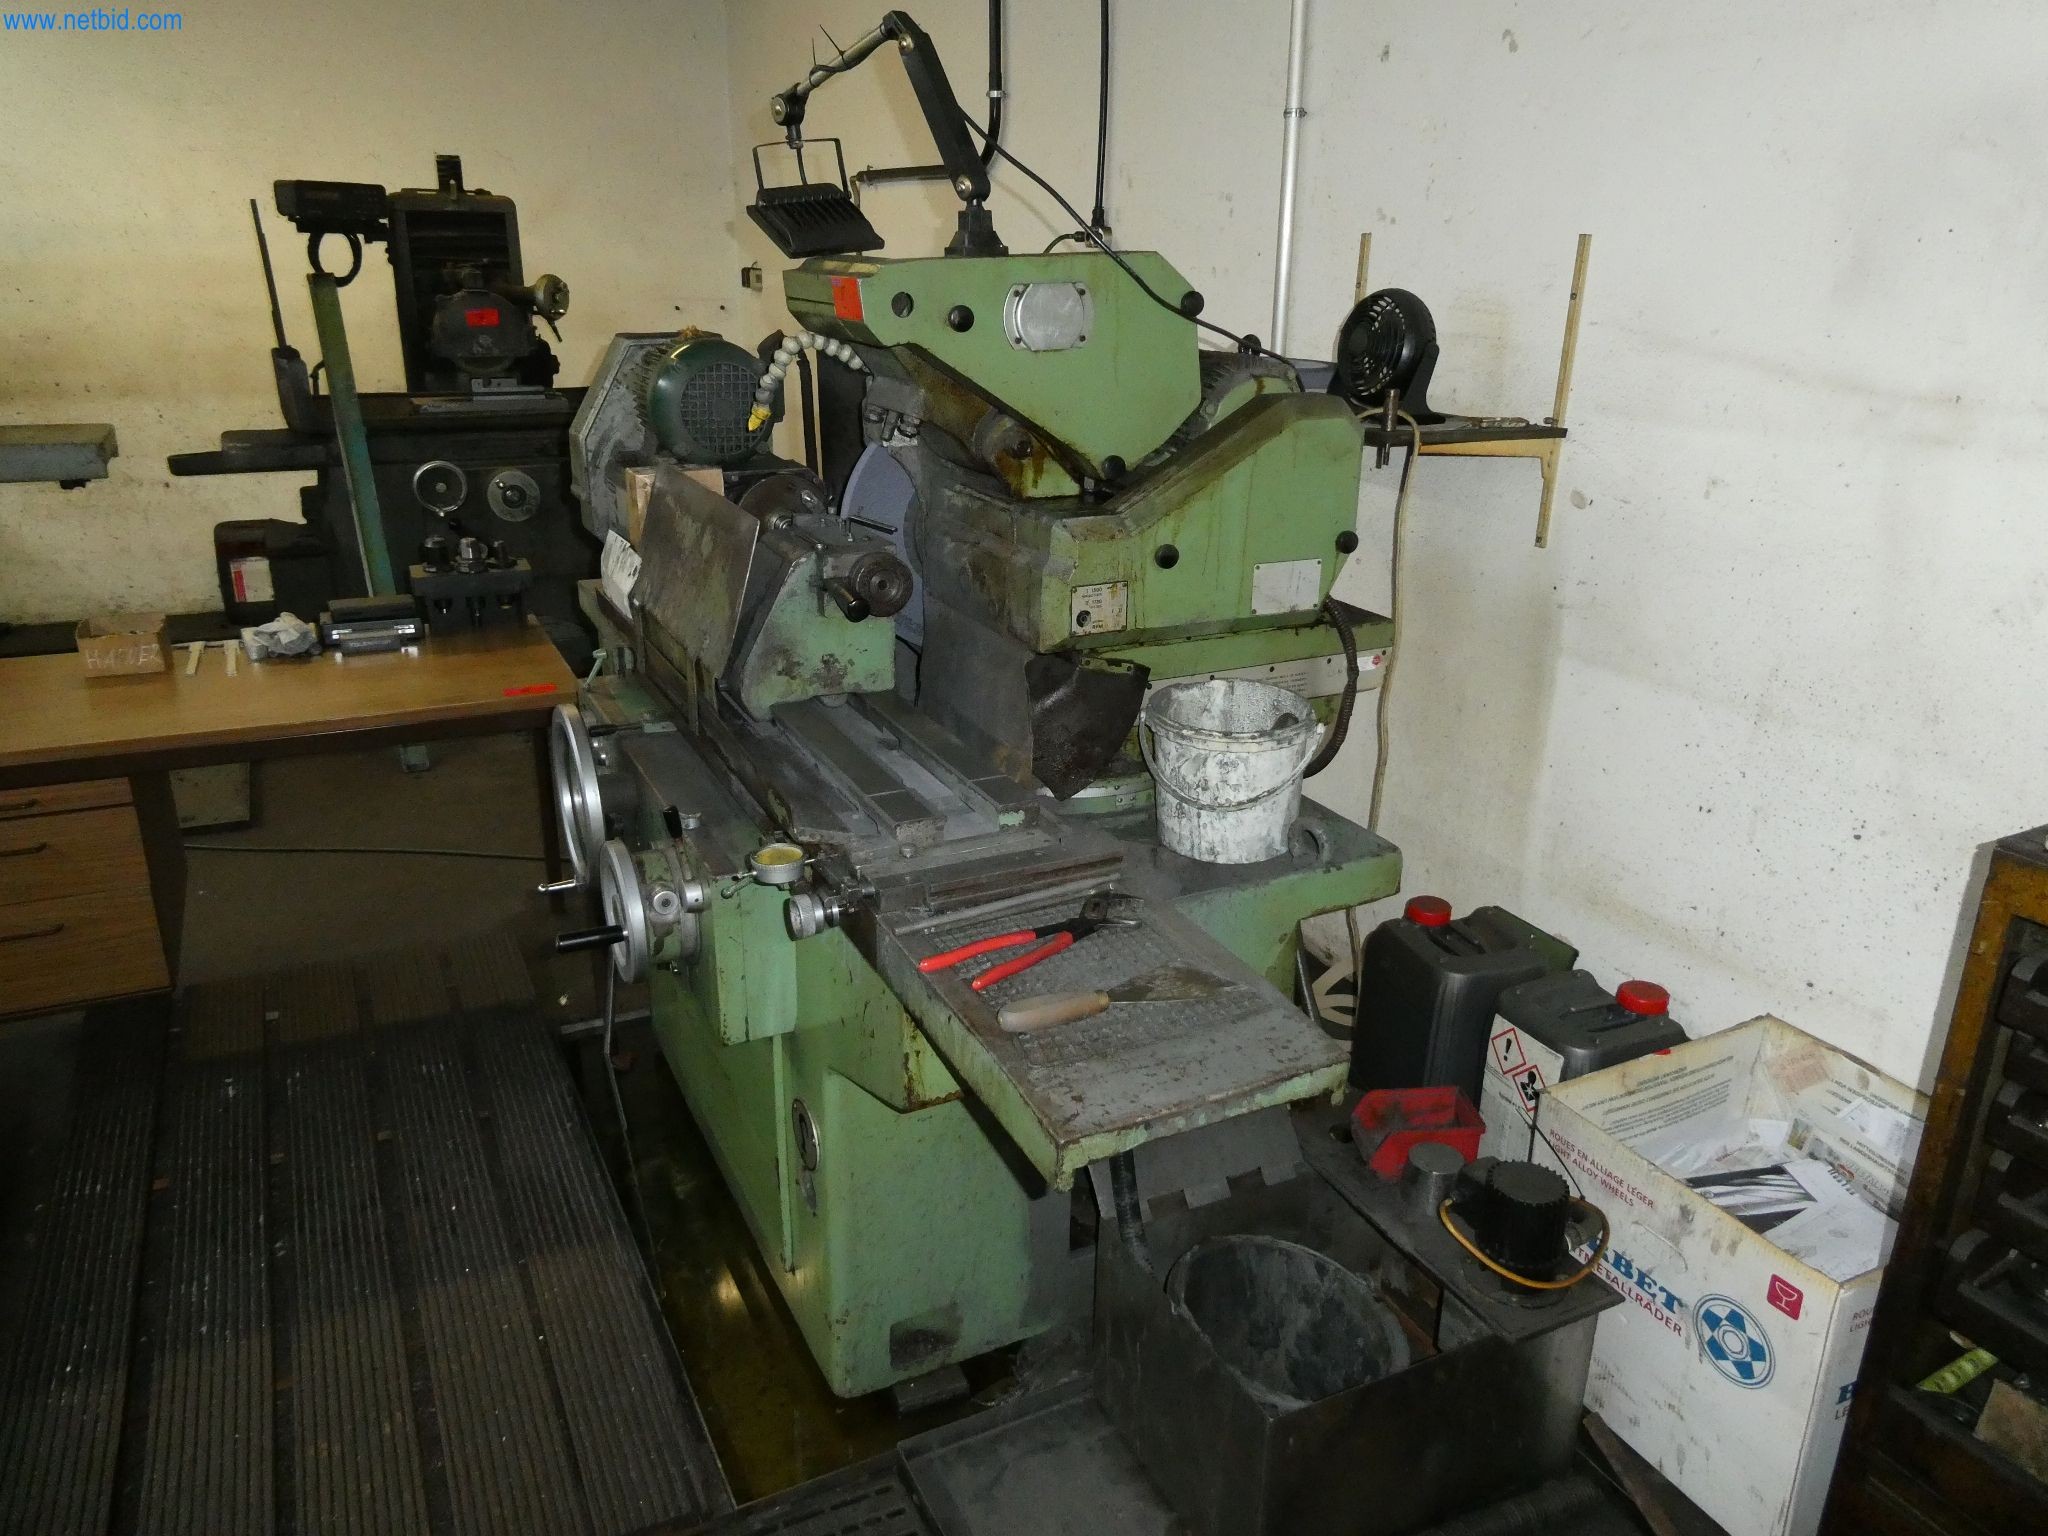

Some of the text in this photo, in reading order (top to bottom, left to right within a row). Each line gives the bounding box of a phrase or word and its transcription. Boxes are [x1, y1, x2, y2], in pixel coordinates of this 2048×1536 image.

[1550, 1129, 1654, 1208] ROUES EN ALLIAGE LÉGER
[1572, 1158, 1599, 1180] ALLOY
[1600, 1176, 1634, 1207] WHEELS
[1852, 1306, 1873, 1321] ROU
